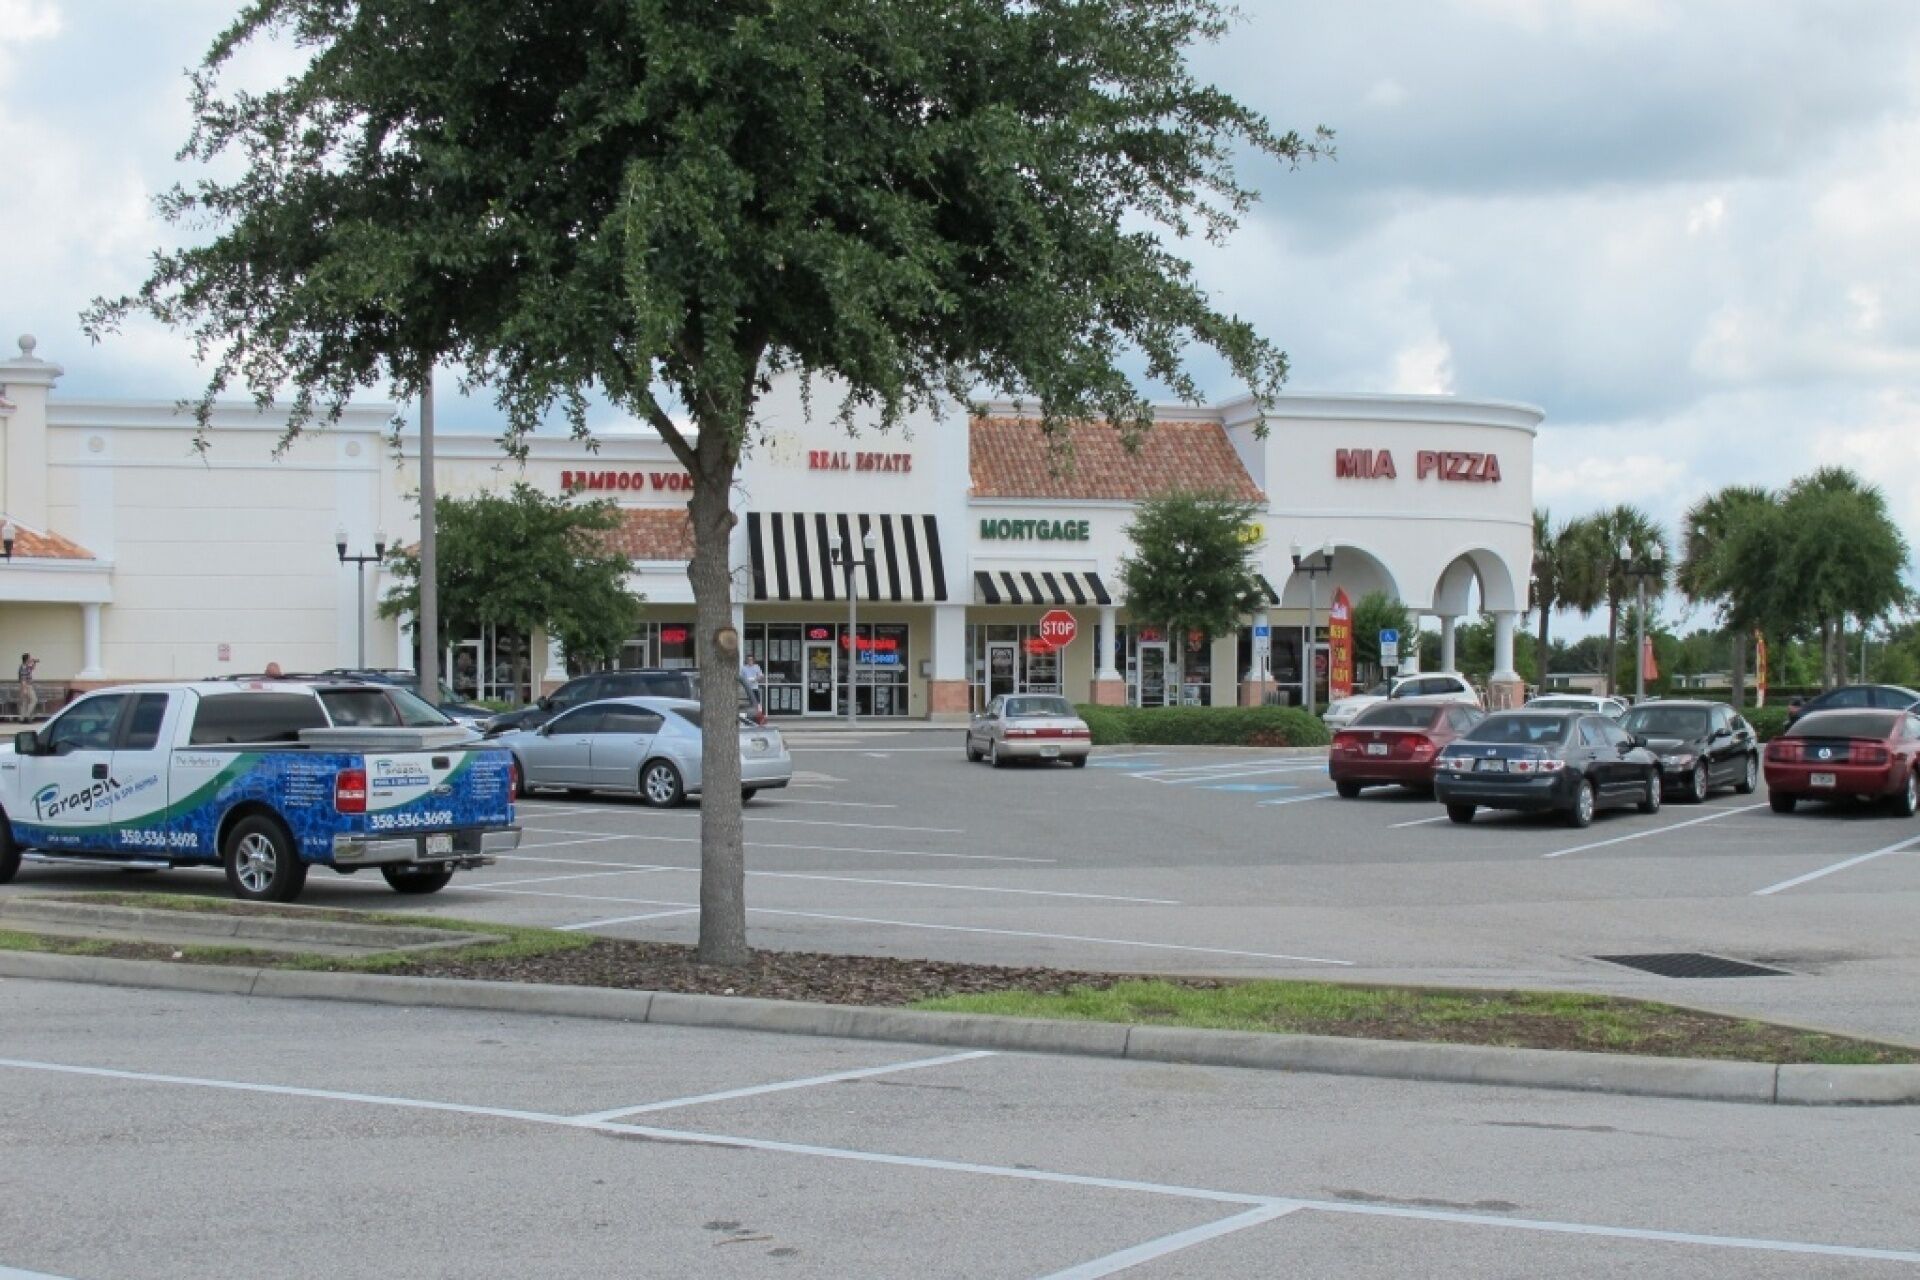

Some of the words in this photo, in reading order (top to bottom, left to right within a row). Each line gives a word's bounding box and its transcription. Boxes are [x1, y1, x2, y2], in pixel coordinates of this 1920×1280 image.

[808, 450, 850, 471] REAL
[855, 452, 912, 473] ESTATE
[1335, 448, 1397, 479] MIA
[1417, 450, 1501, 482] PIZZA
[980, 519, 1090, 541] MORTGAGE
[1042, 622, 1074, 635] STOP
[32, 776, 121, 821] Paragon
[371, 811, 453, 829] 352-536-3692
[120, 829, 198, 847] 352-536-3692
